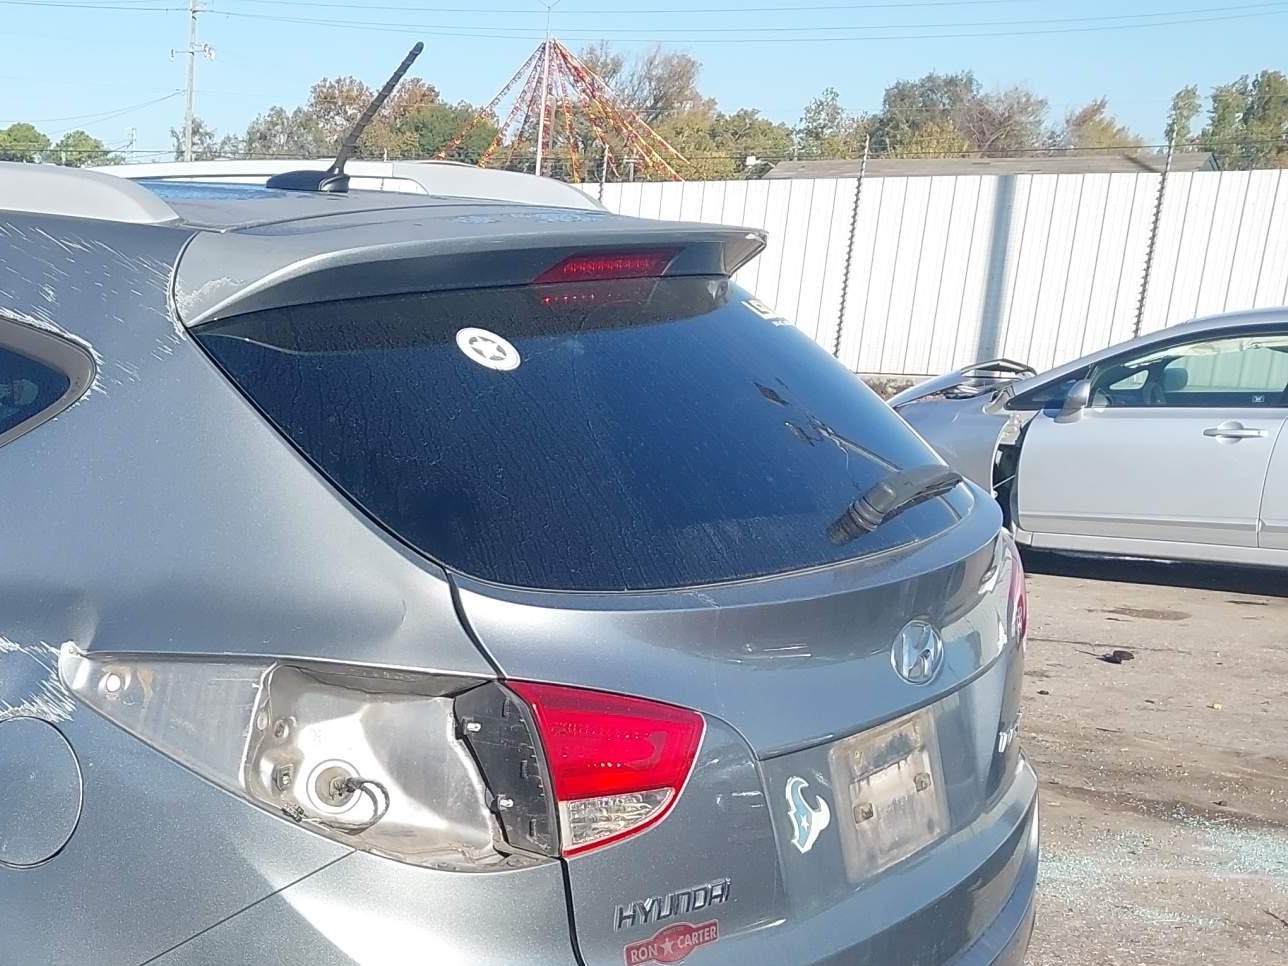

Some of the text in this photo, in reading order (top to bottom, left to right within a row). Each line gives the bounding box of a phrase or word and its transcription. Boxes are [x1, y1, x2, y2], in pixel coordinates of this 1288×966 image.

[614, 877, 732, 931] HYUNDAI
[630, 943, 658, 963] RON
[677, 926, 717, 949] CARTER
